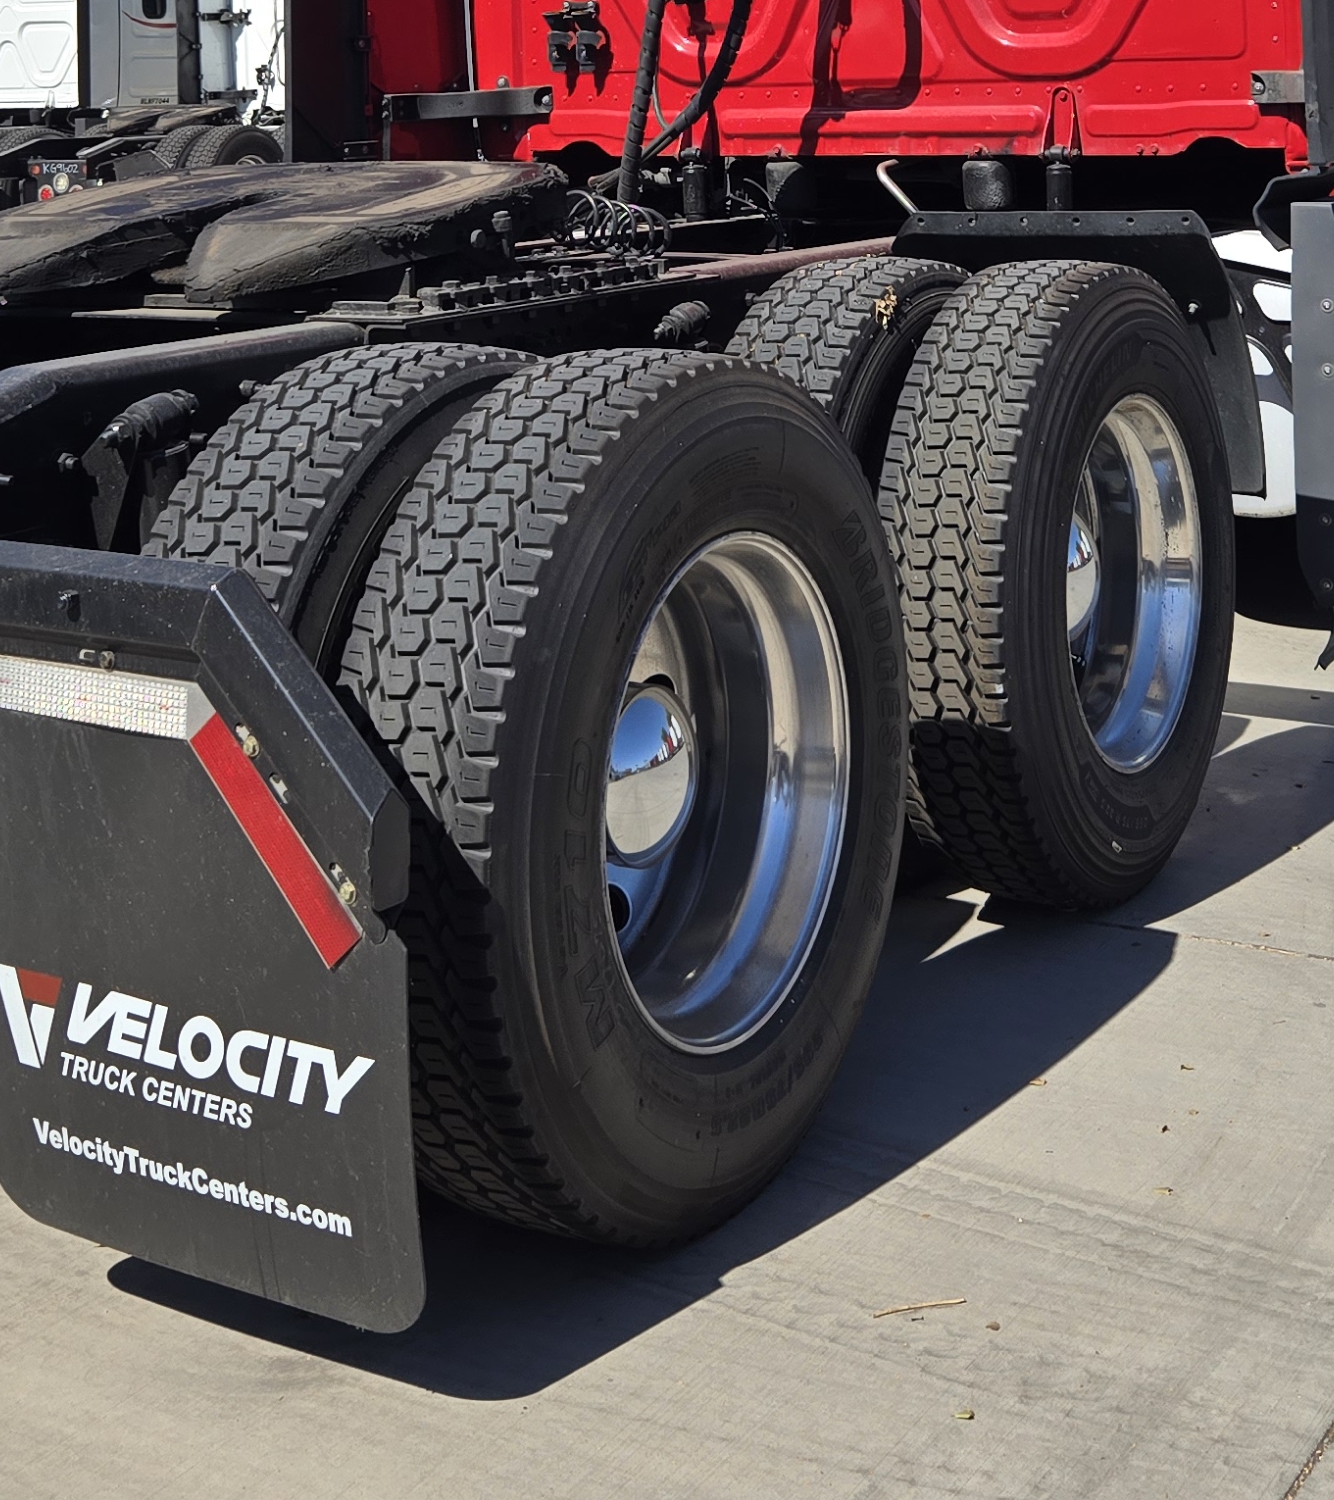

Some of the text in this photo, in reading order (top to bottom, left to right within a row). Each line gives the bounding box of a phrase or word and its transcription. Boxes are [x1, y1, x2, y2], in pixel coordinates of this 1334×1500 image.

[832, 510, 902, 922] BRIDGESTONE
[563, 737, 617, 1053] M710
[60, 1051, 253, 1130] TRUCK CENTERS
[66, 981, 375, 1115] VELOCITY
[32, 1117, 354, 1238] VelocityTruckCenters.com
